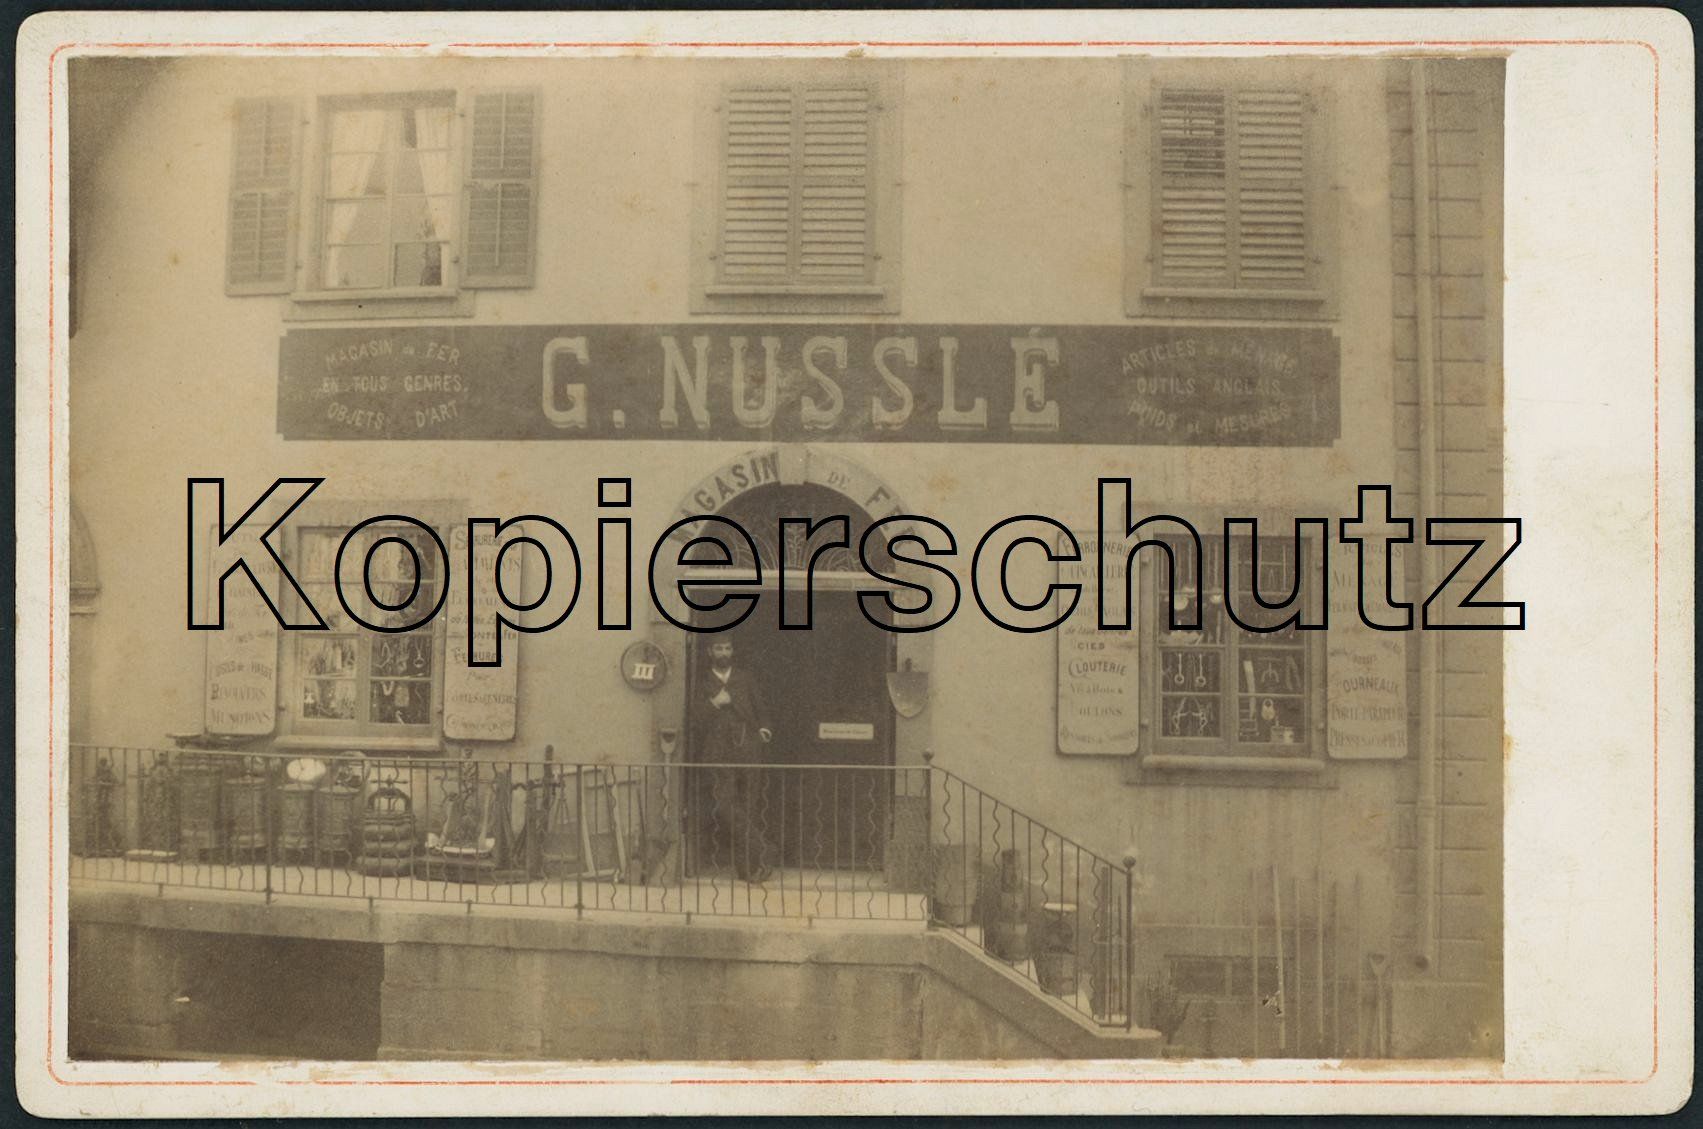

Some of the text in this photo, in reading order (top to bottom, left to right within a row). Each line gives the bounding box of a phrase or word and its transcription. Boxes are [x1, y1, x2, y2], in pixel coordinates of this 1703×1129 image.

[325, 339, 393, 370] MAGASIN
[425, 341, 461, 366] FER
[1121, 339, 1197, 376] ARTICLES
[353, 375, 390, 393] TOUS
[1136, 377, 1281, 396] OUTILS ANGLAIS
[327, 400, 459, 430] OBJETS D'ART
[1067, 658, 1128, 679] CLOUTERIE
